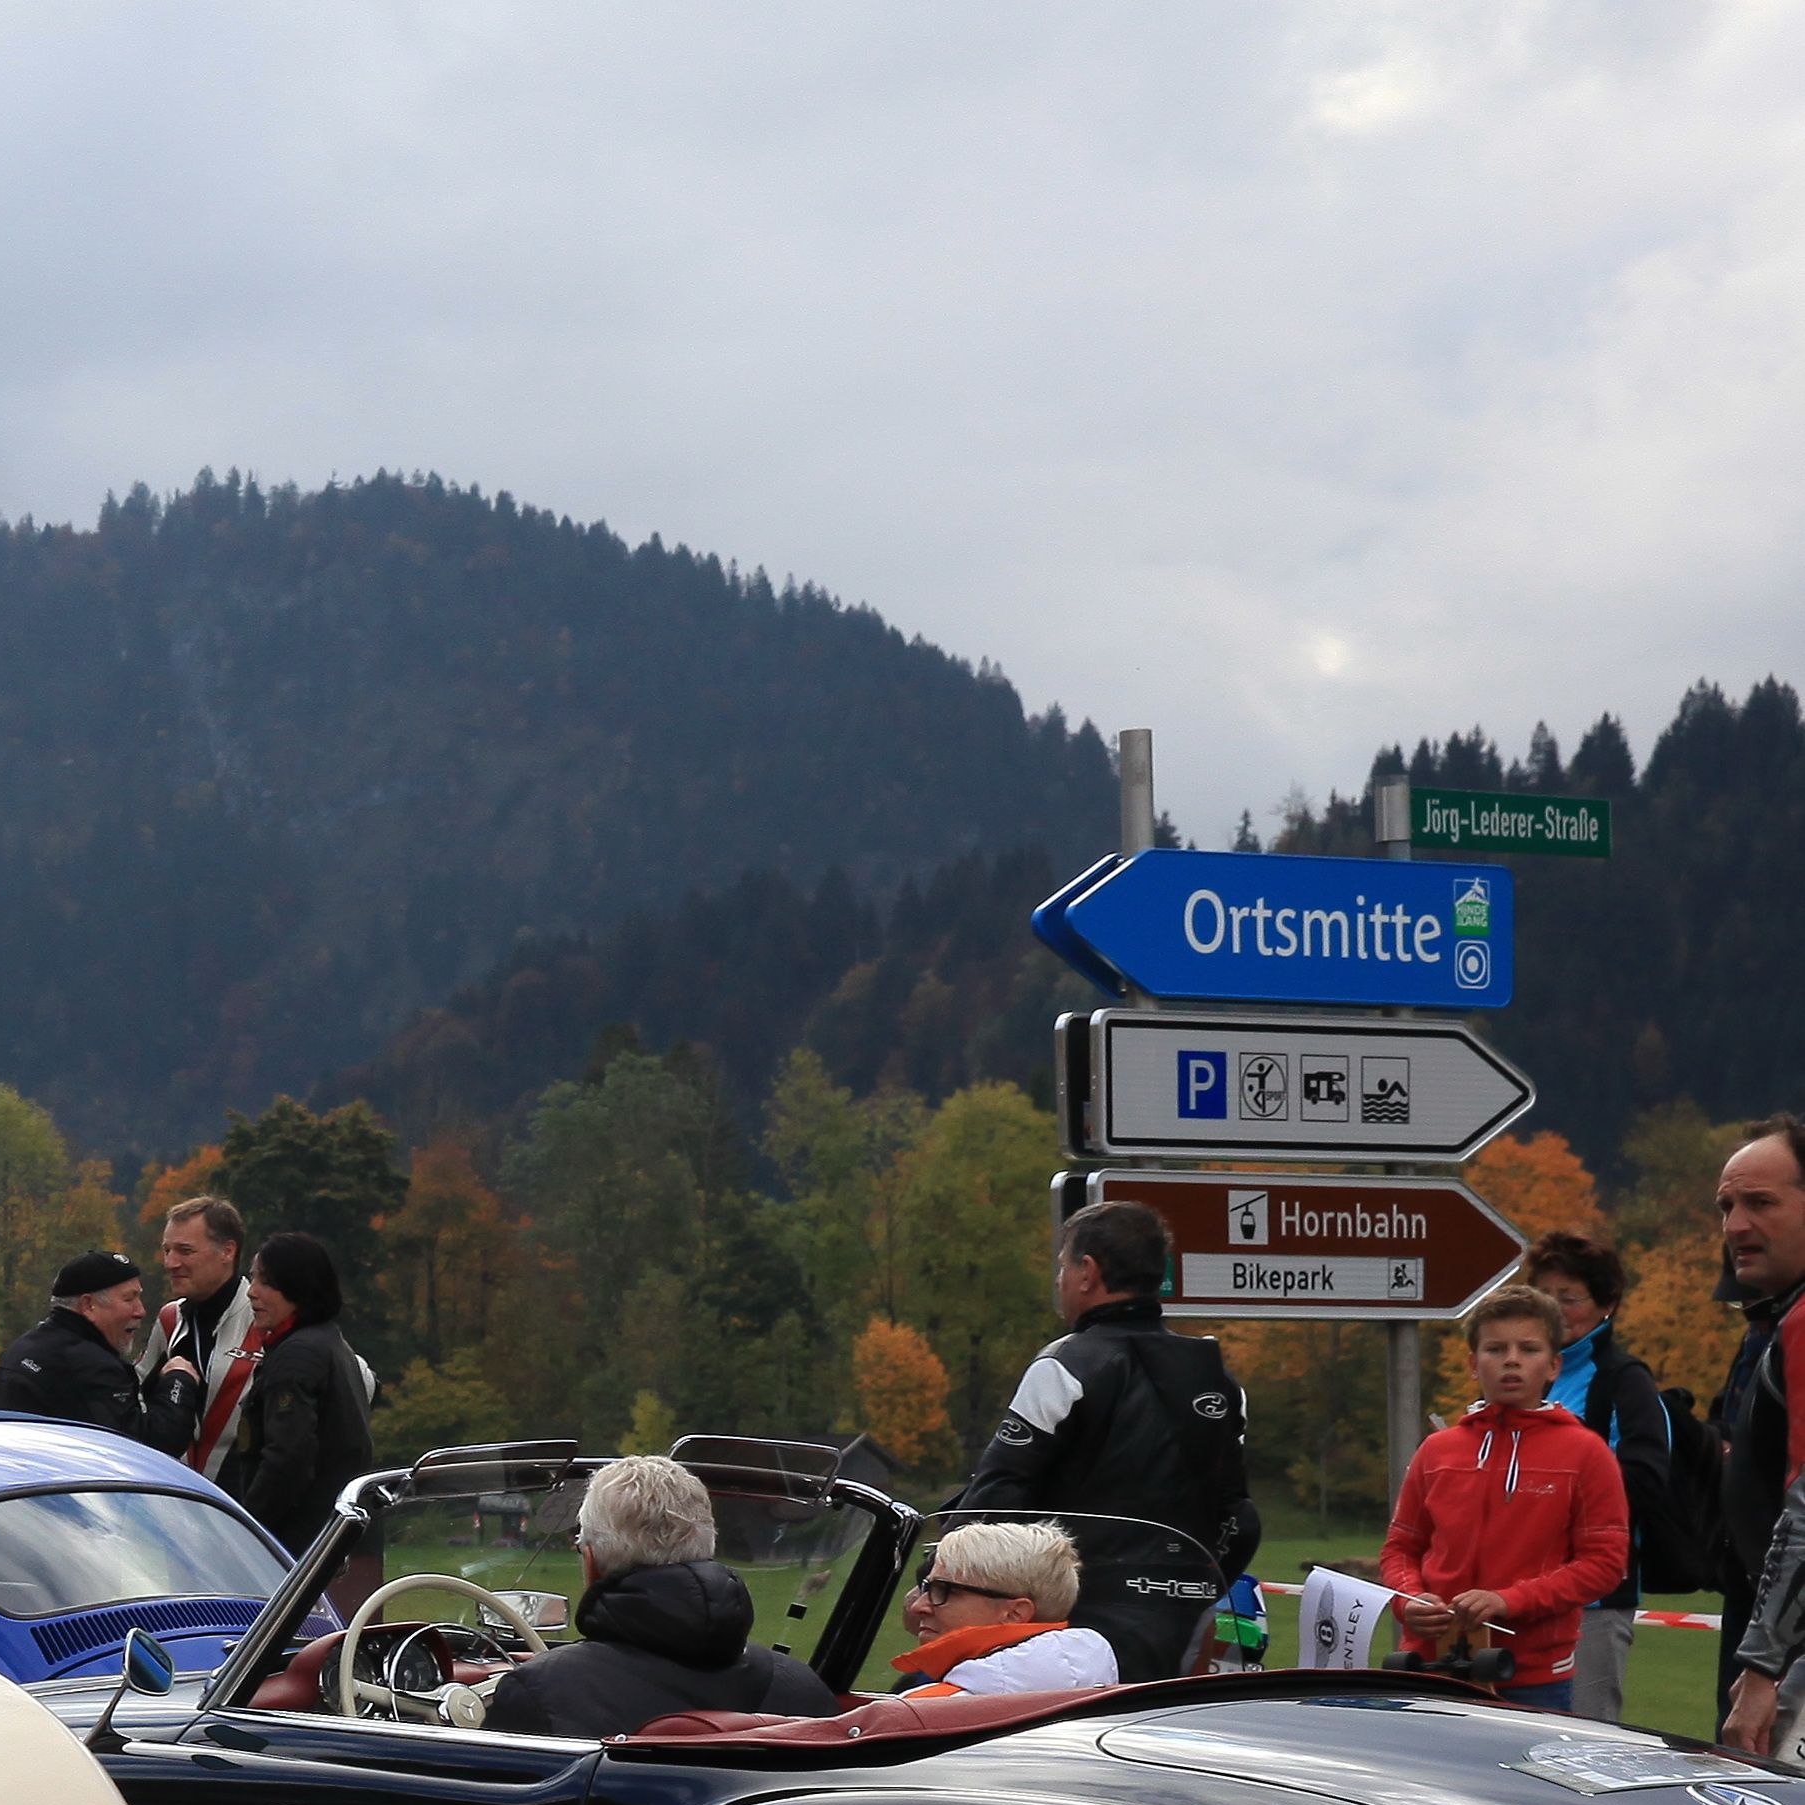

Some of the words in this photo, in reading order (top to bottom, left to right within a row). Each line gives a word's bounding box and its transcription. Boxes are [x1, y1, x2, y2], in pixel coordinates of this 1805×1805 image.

[1422, 798, 1599, 843] Jörg-Lederer-Straße
[1184, 888, 1442, 963] Ortsmitte
[1188, 1059, 1216, 1111] P
[1280, 1201, 1427, 1240] Hornbahn
[1233, 1263, 1334, 1297] Bikepark
[1344, 1598, 1364, 1669] ENTLEY
